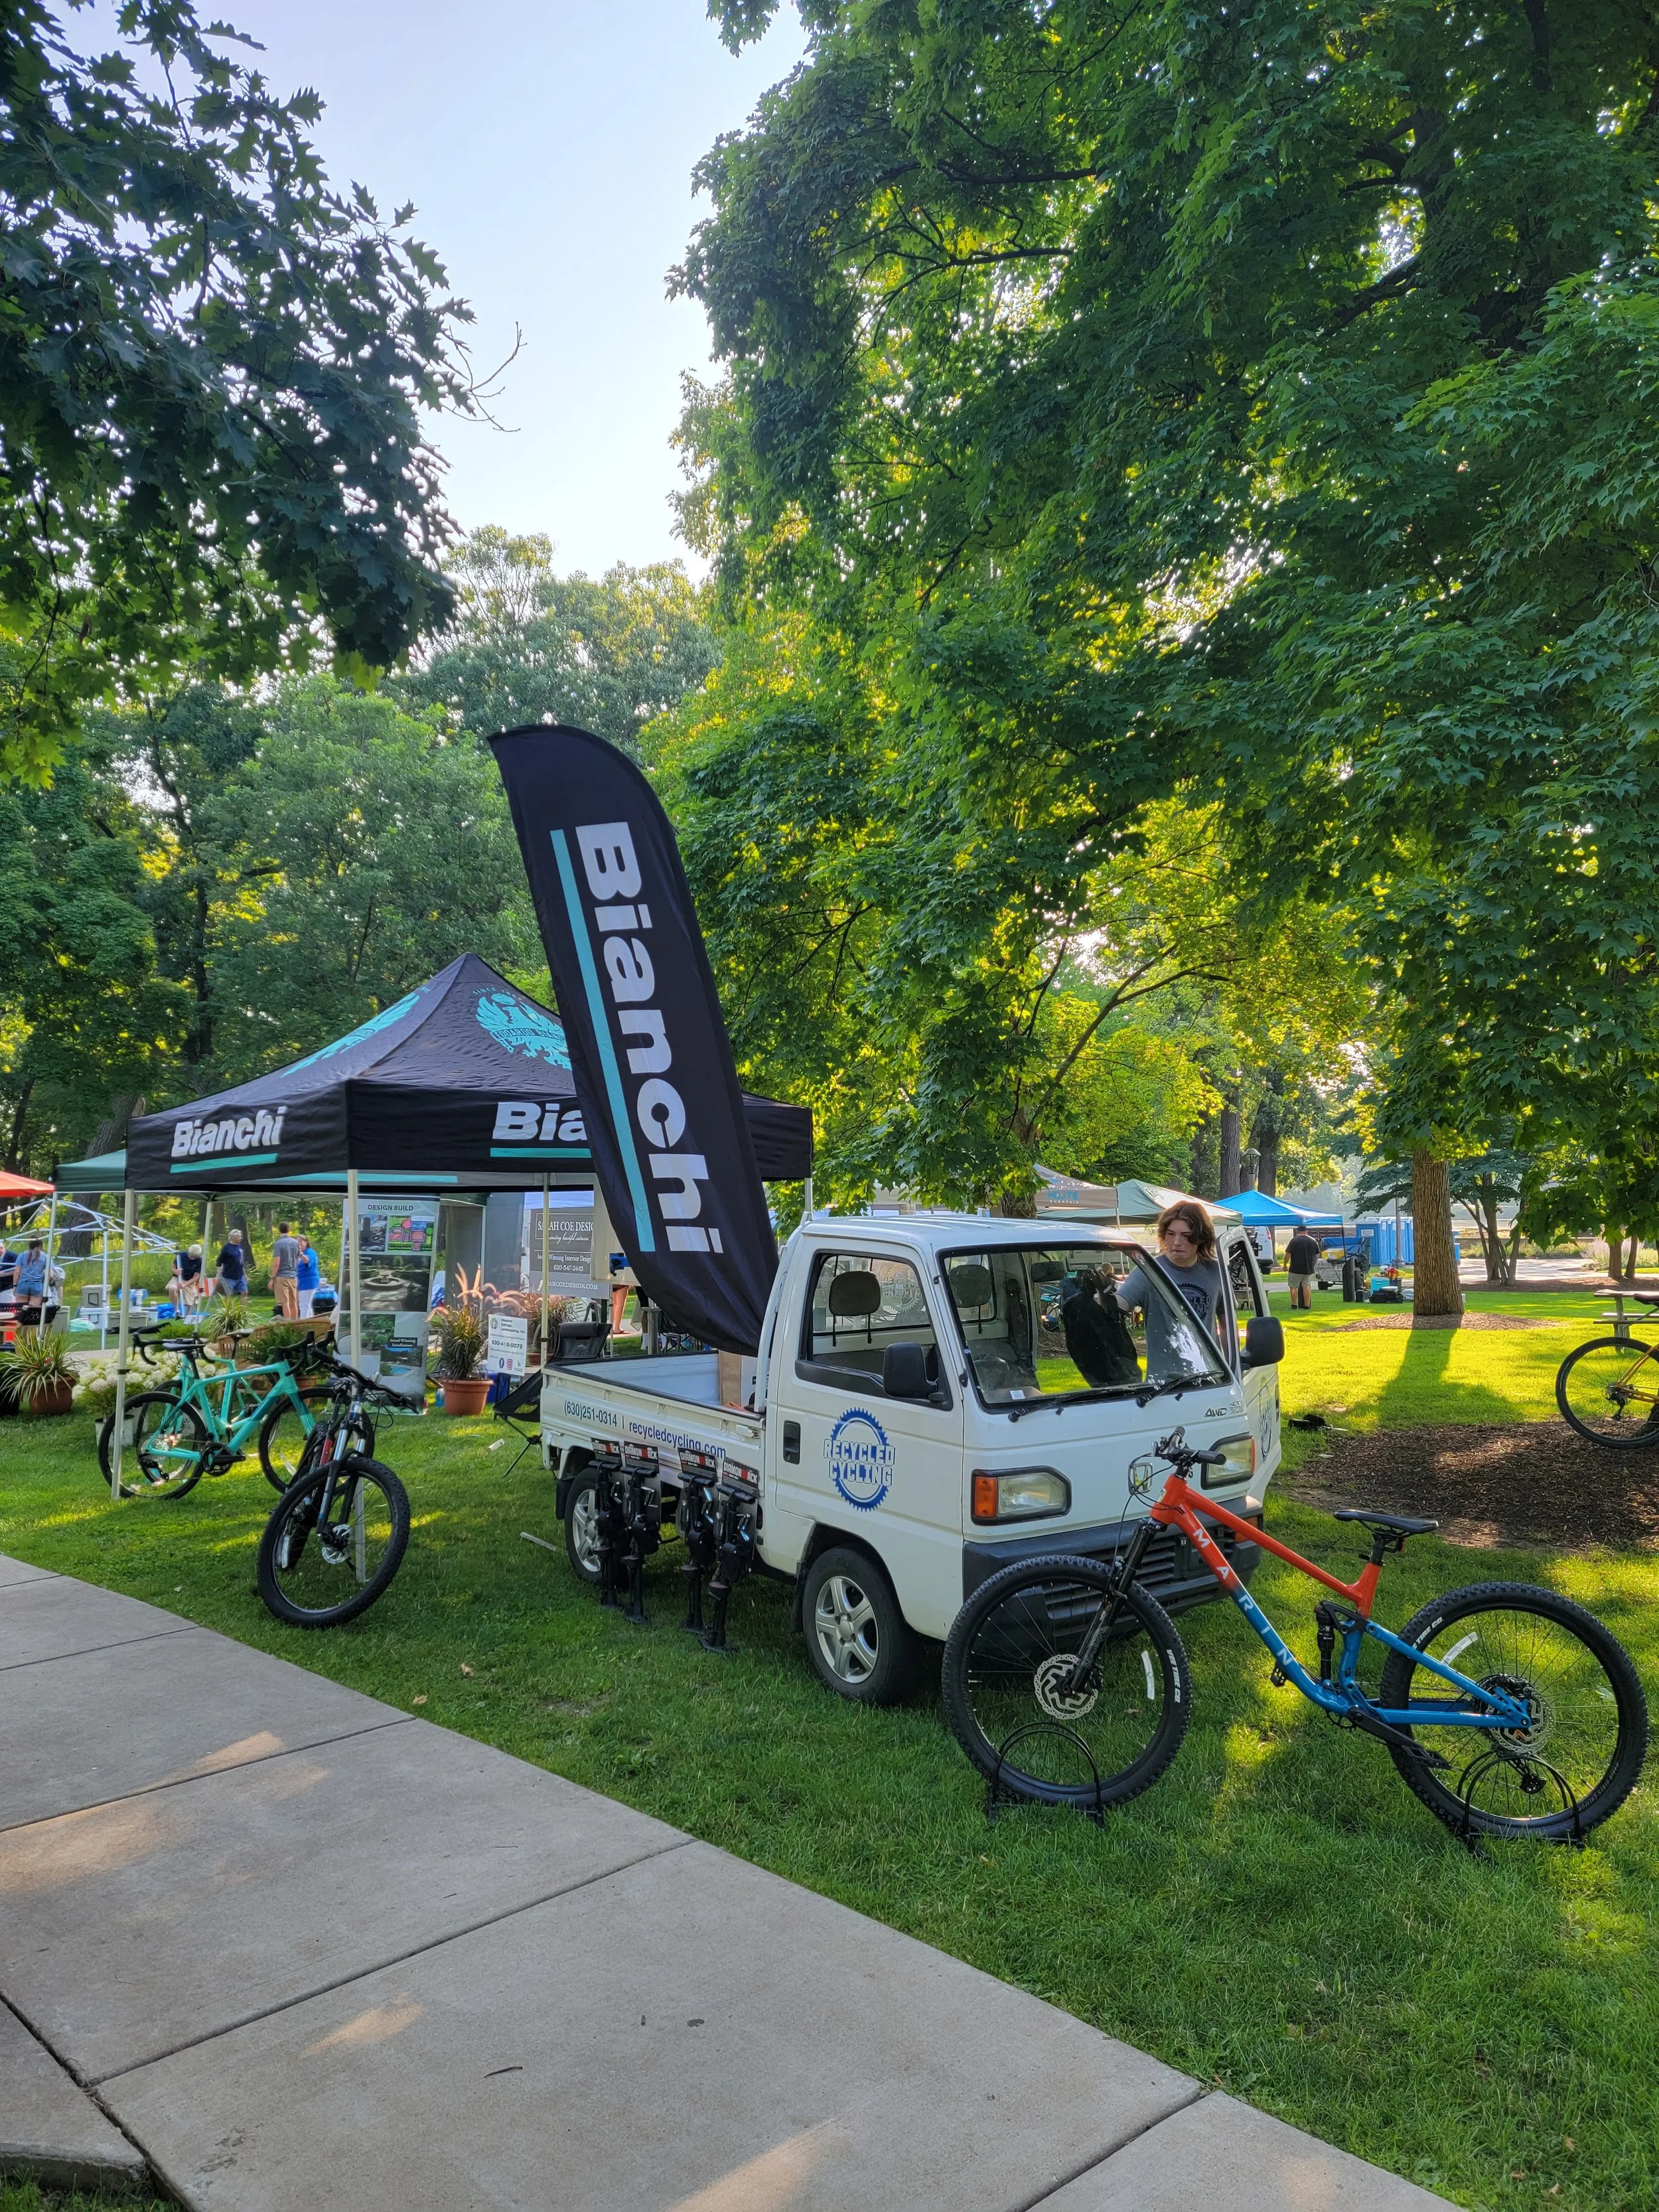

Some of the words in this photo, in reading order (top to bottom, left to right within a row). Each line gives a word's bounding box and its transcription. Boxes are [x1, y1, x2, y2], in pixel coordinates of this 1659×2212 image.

[575, 821, 723, 1253] Bianchi
[171, 1106, 287, 1157] Bianchi
[538, 1221, 559, 1230] SAH
[560, 1222, 574, 1231] COE
[547, 1280, 598, 1290] AHCOEDESIGN.COM
[491, 1339, 523, 1349] 630-416-0072
[1204, 1408, 1227, 1418] AWD
[564, 1400, 617, 1428] (630)251-0314
[629, 1420, 726, 1459] recycledcycling.com
[824, 1439, 895, 1465] RECYCLED
[829, 1459, 893, 1487] CYCLING
[1193, 1528, 1293, 1666] MARIN
